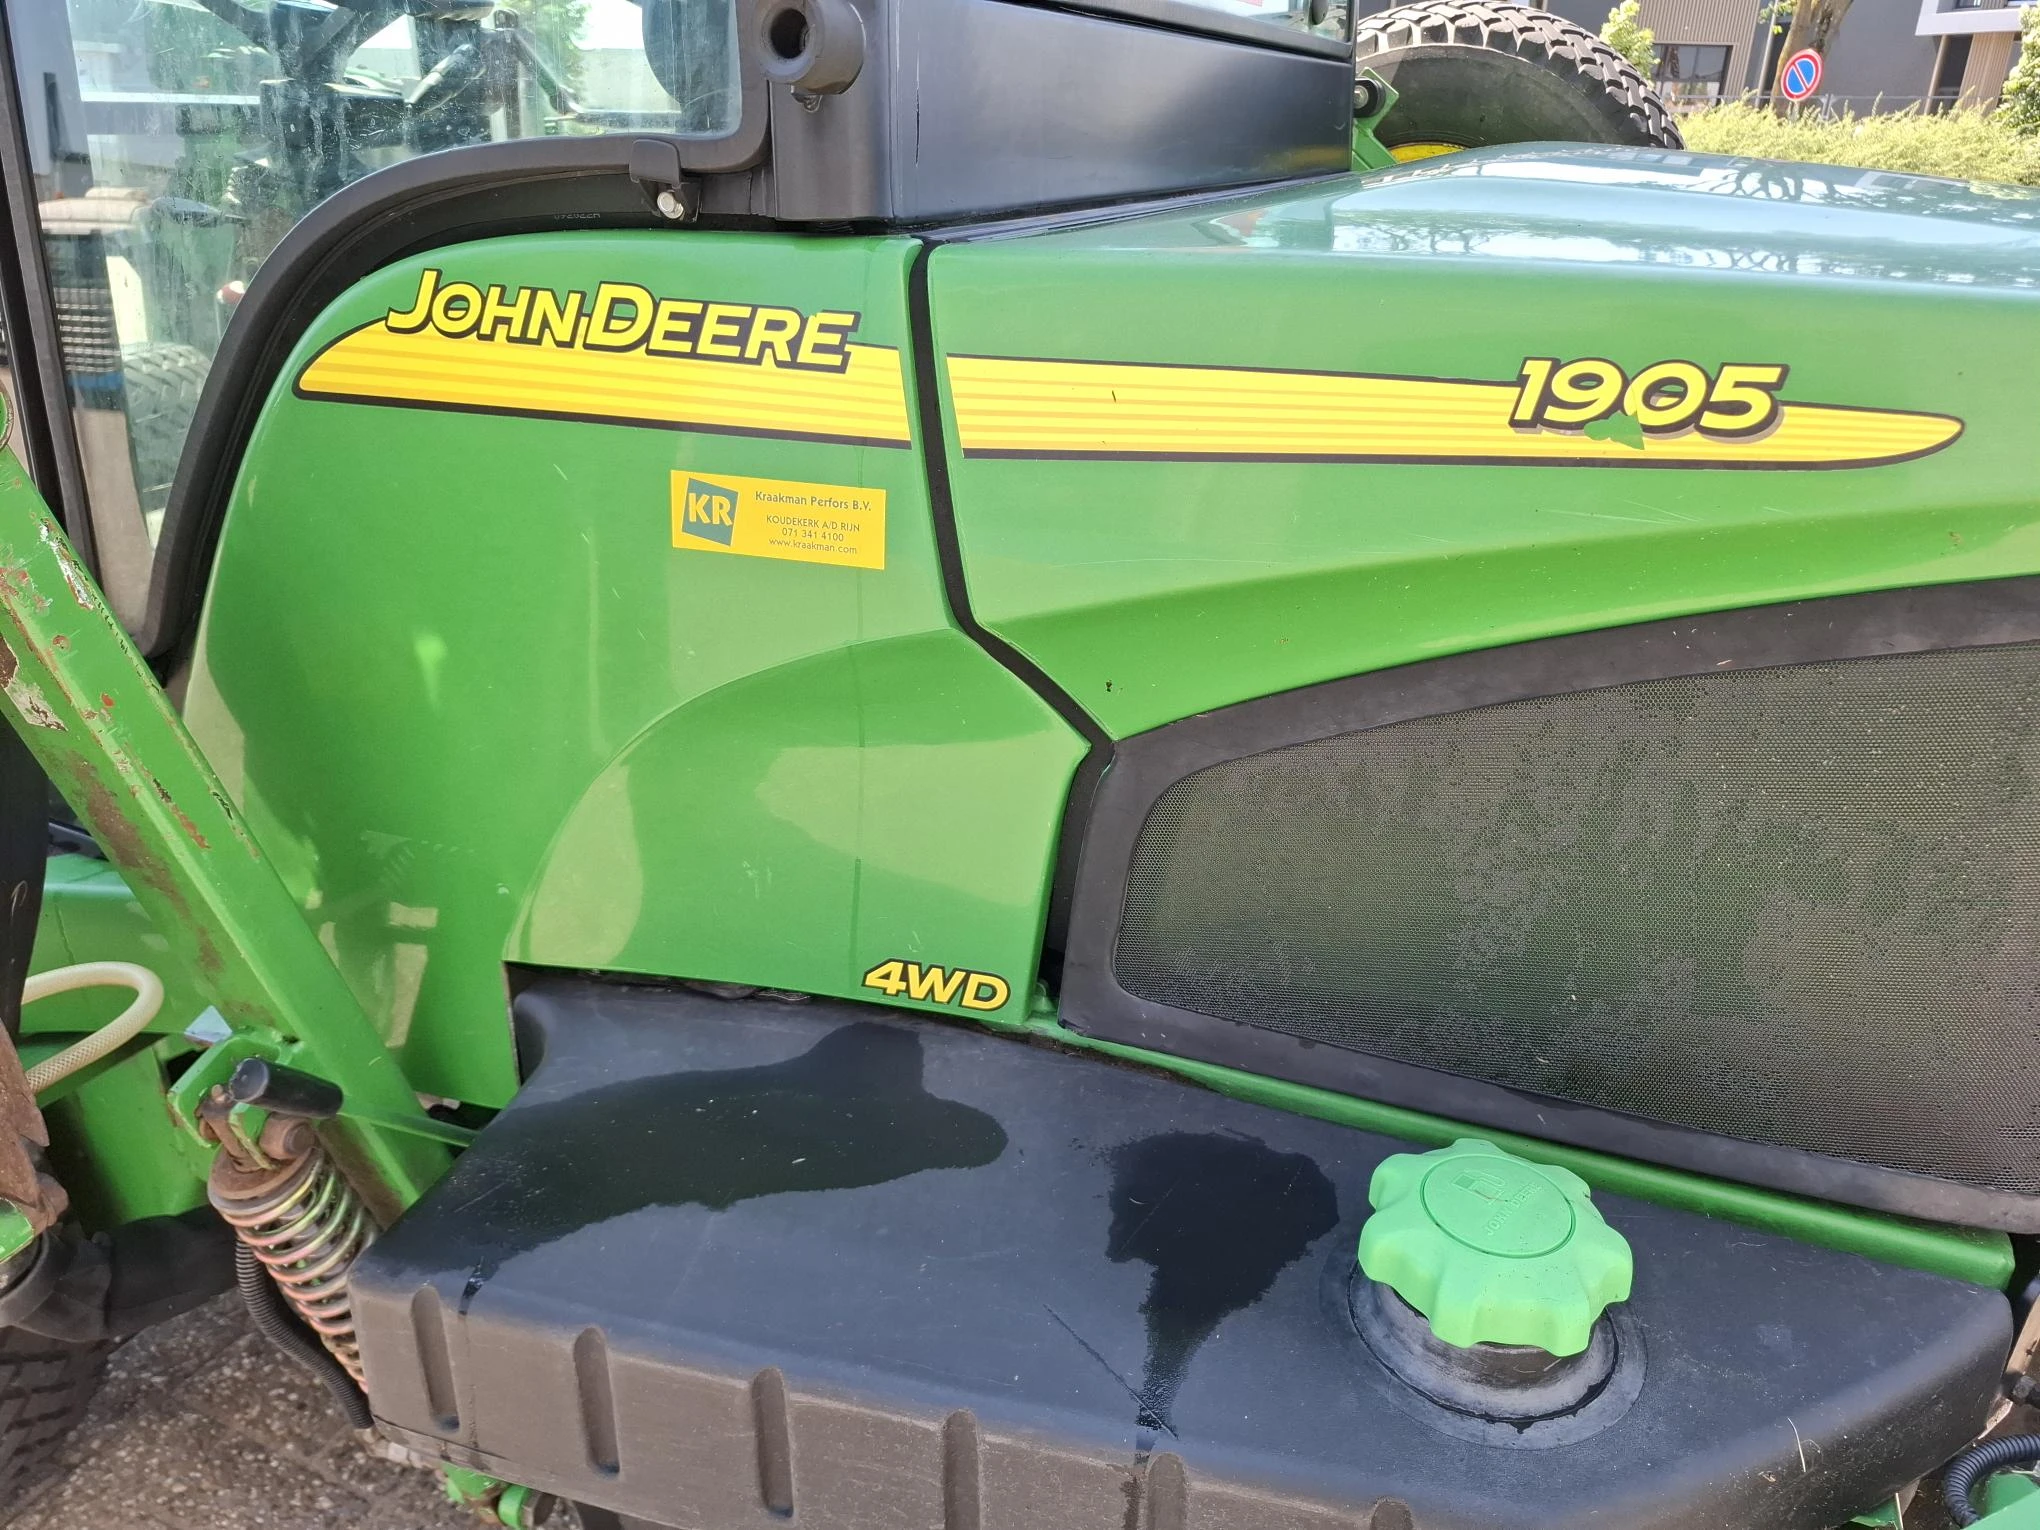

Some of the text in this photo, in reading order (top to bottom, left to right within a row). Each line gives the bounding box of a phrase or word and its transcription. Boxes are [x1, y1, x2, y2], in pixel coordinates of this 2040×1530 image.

[386, 269, 858, 371] JOHN DEERE
[1510, 358, 1788, 436] 1905
[687, 492, 733, 527] KR
[755, 491, 871, 511] Kraakman Perfors B.V.
[766, 515, 860, 532] KOUDEKERK A/D RIJN
[782, 528, 844, 541] 071 341 4100
[769, 538, 857, 554] www.kraakman.com
[863, 960, 1010, 1010] 4WD
